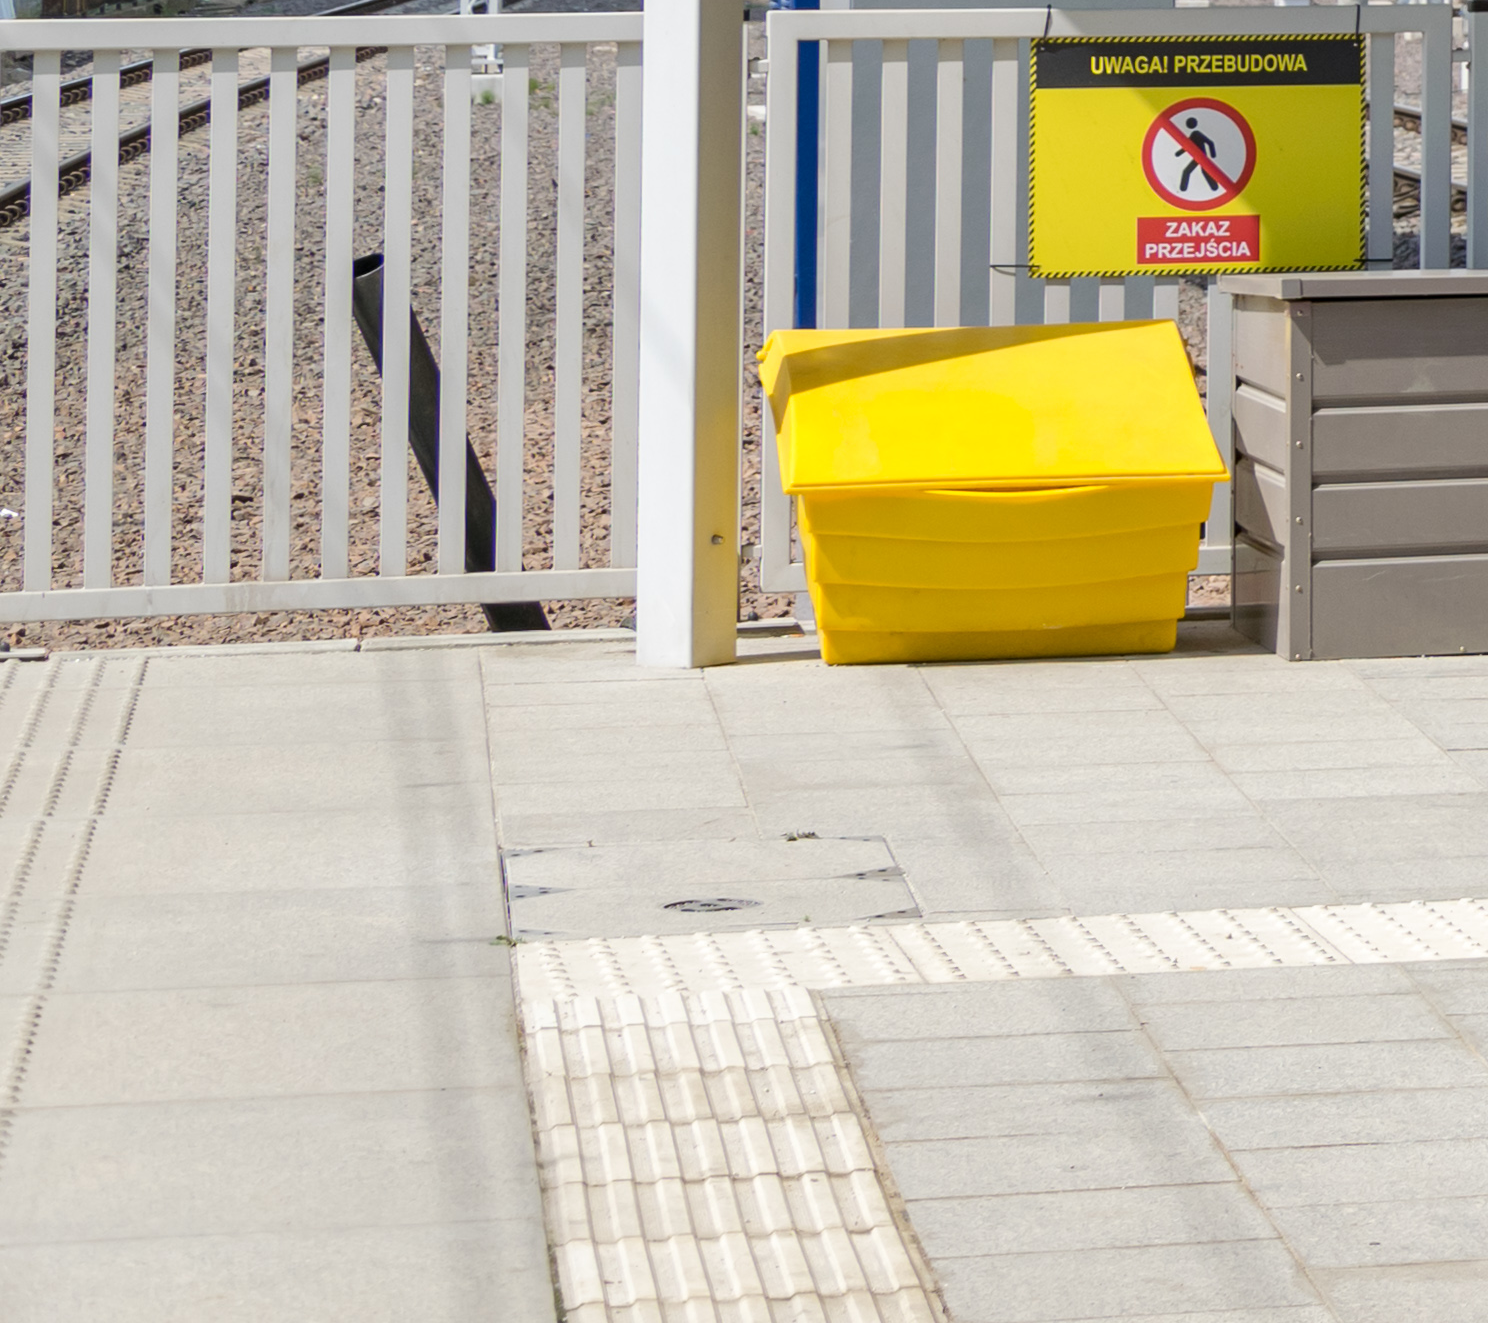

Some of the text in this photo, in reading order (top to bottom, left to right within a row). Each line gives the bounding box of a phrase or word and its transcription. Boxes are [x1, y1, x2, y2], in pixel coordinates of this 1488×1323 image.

[1090, 53, 1308, 75] UWAGA! PRZEBUDOWA
[1165, 221, 1230, 238] ZAKAZ
[1145, 238, 1252, 259] PRZEJŚCIA
